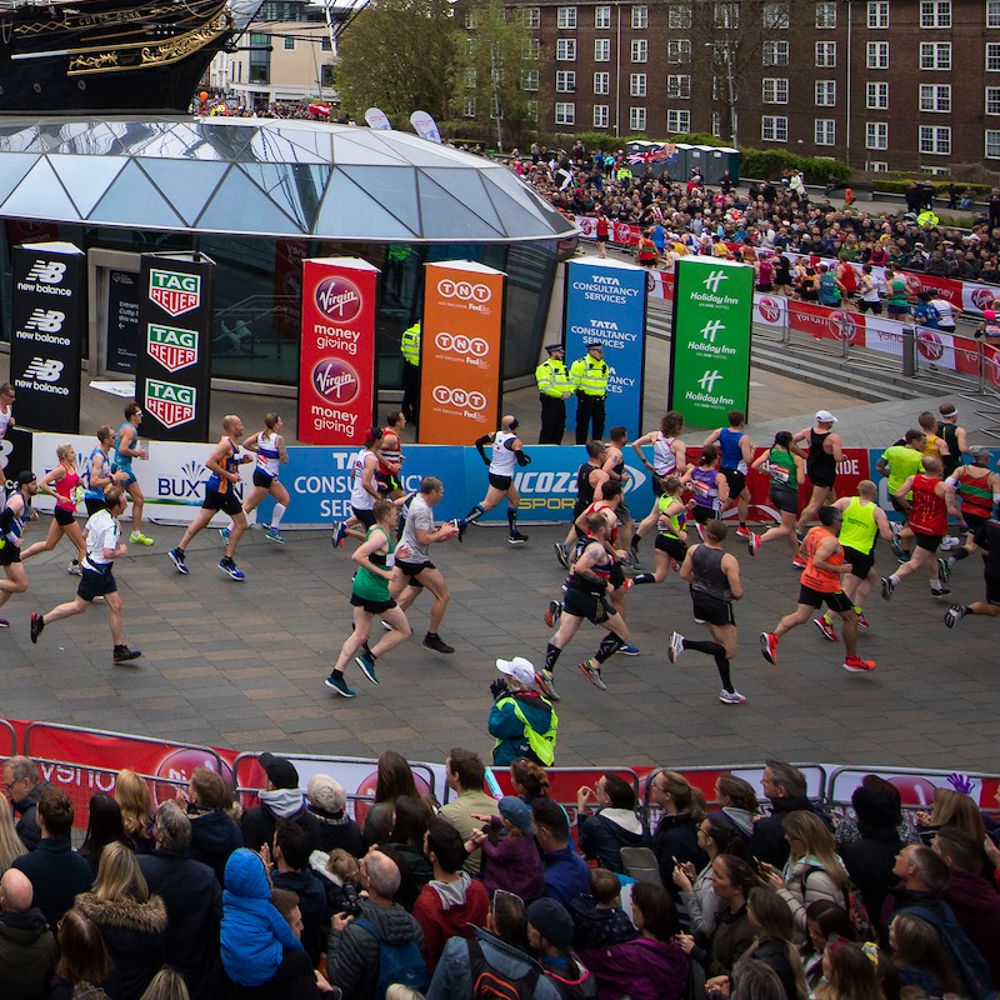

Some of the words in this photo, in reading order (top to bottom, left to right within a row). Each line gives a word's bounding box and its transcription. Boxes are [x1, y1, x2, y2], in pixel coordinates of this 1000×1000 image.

[154, 273, 195, 291] TAG
[592, 275, 620, 285] TATA
[18, 282, 35, 292] new
[36, 283, 72, 297] balance
[440, 281, 489, 301] TNT
[573, 282, 639, 297] CONSULTANCY
[584, 291, 626, 304] SERVICES
[152, 289, 196, 312] HEUER
[319, 282, 358, 317] Virgin
[690, 292, 724, 304] Holiday
[724, 296, 738, 305] Inn
[590, 319, 618, 330] TATA
[16, 330, 34, 340] new
[35, 331, 71, 346] balance
[152, 328, 193, 347] TAG
[314, 324, 360, 343] money
[571, 325, 637, 342] CONSULTANCY
[437, 334, 486, 355] TNT
[583, 336, 624, 349] SERVICES
[688, 341, 721, 354] Holiday
[721, 345, 736, 355] Inn
[150, 344, 194, 368] HEUER
[15, 379, 32, 389] new
[33, 381, 69, 396] balance
[316, 363, 356, 398] Virgin
[150, 383, 191, 403] TAG
[435, 387, 484, 408] TNT
[685, 391, 719, 405] Holiday
[720, 396, 734, 405] Inn
[148, 400, 192, 424] HEUER
[311, 406, 358, 425] money
[836, 459, 860, 475] IDE
[518, 498, 576, 510] SPOR
